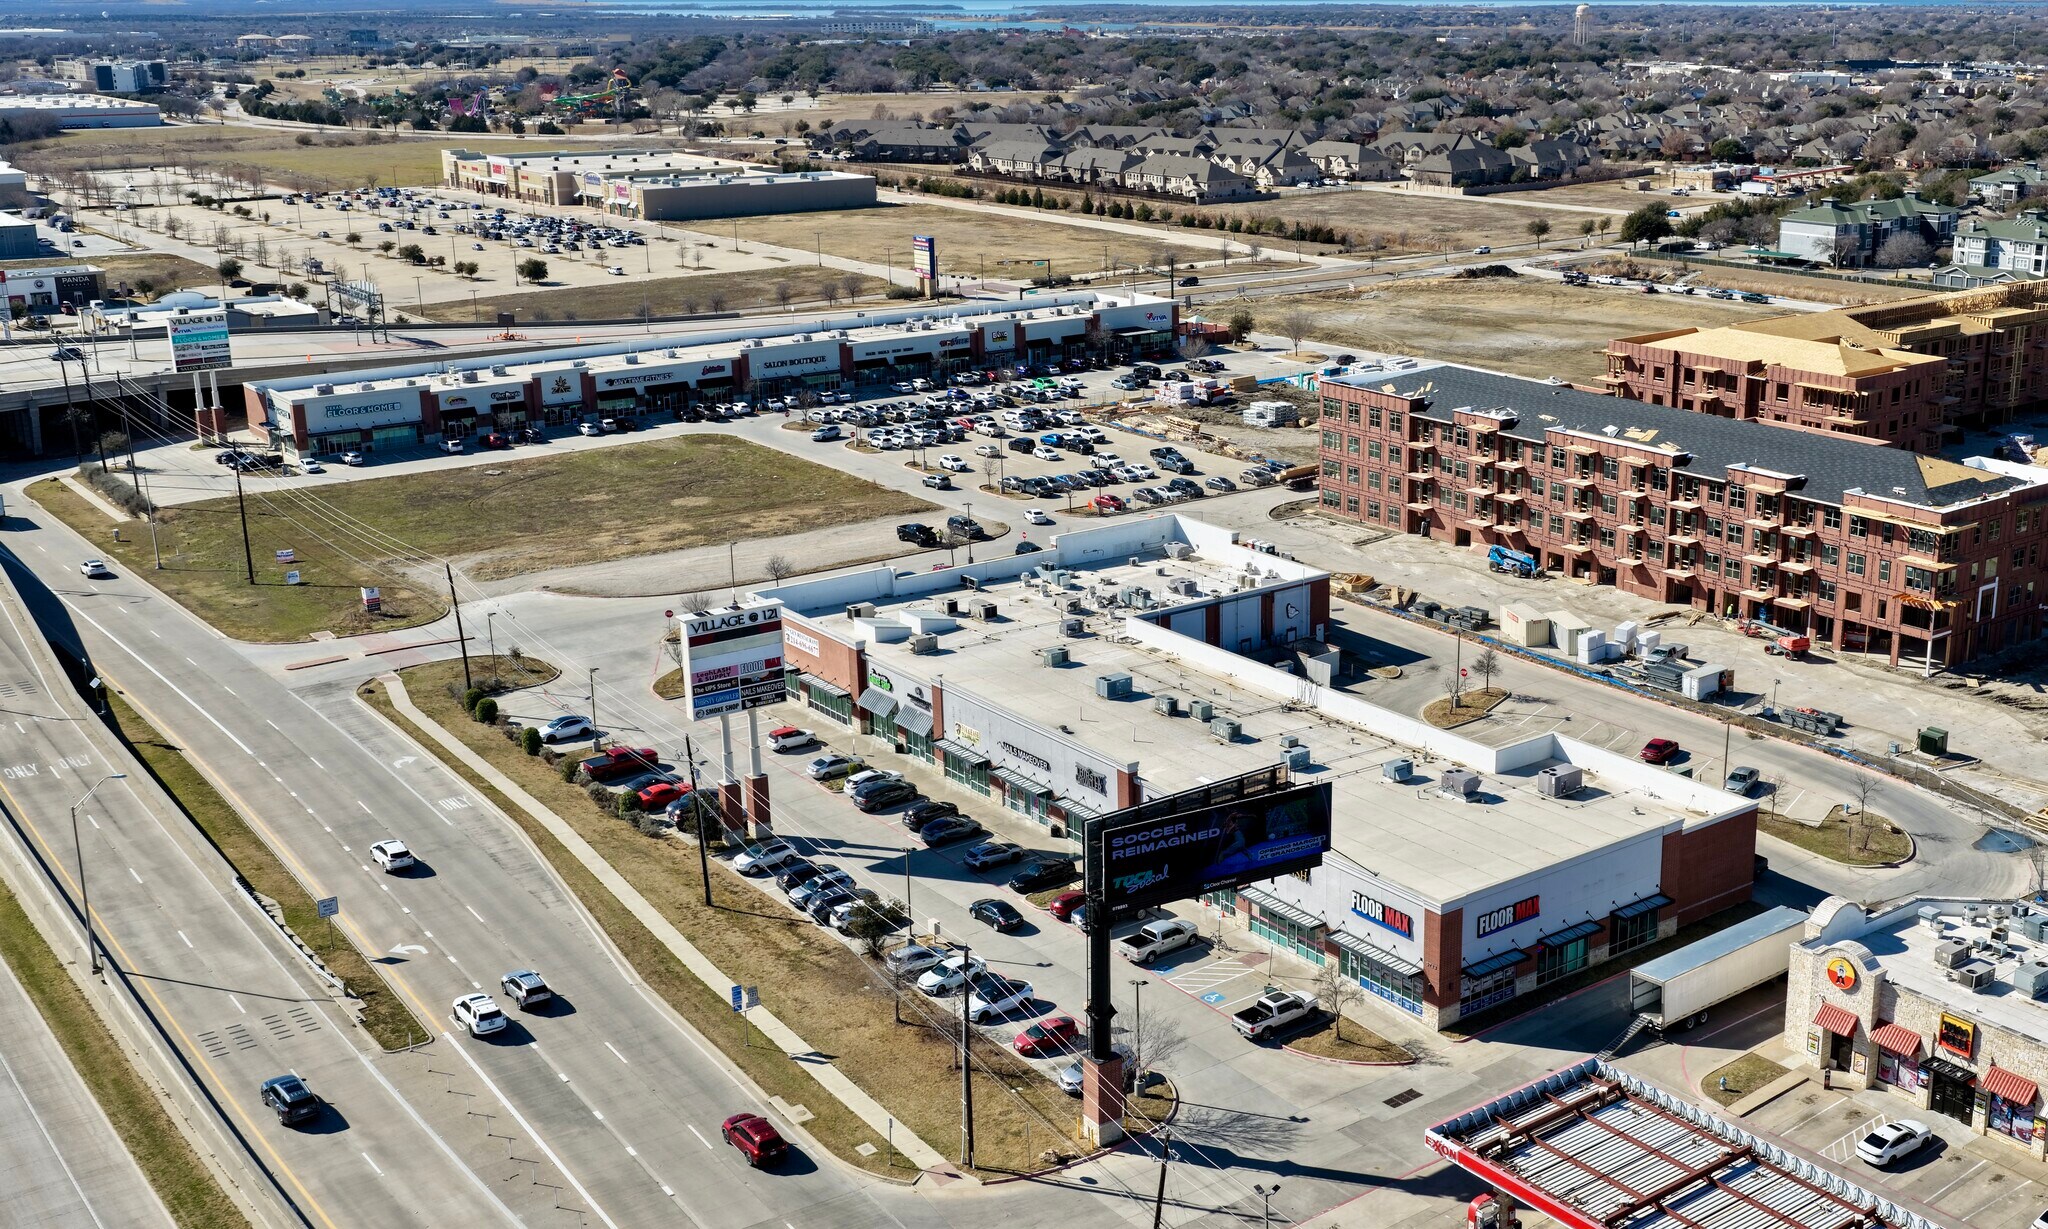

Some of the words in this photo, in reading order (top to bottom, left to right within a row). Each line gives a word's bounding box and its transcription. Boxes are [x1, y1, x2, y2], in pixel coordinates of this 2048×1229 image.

[171, 317, 204, 325] VILLAGE
[764, 360, 788, 369] SALON
[789, 356, 826, 366] BOUTIQUE
[614, 376, 644, 386] ANYTIME
[644, 372, 674, 382] FITNESS
[327, 407, 359, 418] FLOOR
[367, 403, 394, 414] HOME
[690, 614, 745, 634] VILLAGE
[749, 612, 758, 622] @
[762, 608, 778, 620] 121
[740, 660, 764, 674] FLOOR
[705, 672, 731, 681] SUPPLY
[741, 686, 756, 696] NAILS
[757, 681, 785, 693] MAKEOVER
[706, 706, 724, 716] SMOKE
[725, 703, 739, 711] SHOP
[59, 754, 91, 769] ONLY
[1001, 742, 1018, 757] NAILS
[1018, 748, 1048, 770] MAKEOVER
[4, 763, 40, 779] ONLY
[439, 795, 472, 810] ONLY
[1112, 823, 1186, 847] SOCCER
[1112, 827, 1220, 860] REIMAGINED
[1260, 844, 1291, 854] OPENING
[1293, 838, 1319, 847] MARCH
[1270, 842, 1320, 857] GRANDSCAPE
[1113, 870, 1153, 888] TOCA
[1127, 864, 1169, 894] Social
[1210, 881, 1220, 889] Clear
[1220, 877, 1237, 886] Channel
[1352, 890, 1383, 922] FLOOR
[1384, 906, 1410, 934] MAX
[1479, 906, 1513, 935] FLOOR
[1516, 895, 1540, 920] MAX
[1425, 1135, 1457, 1160] EXXON
